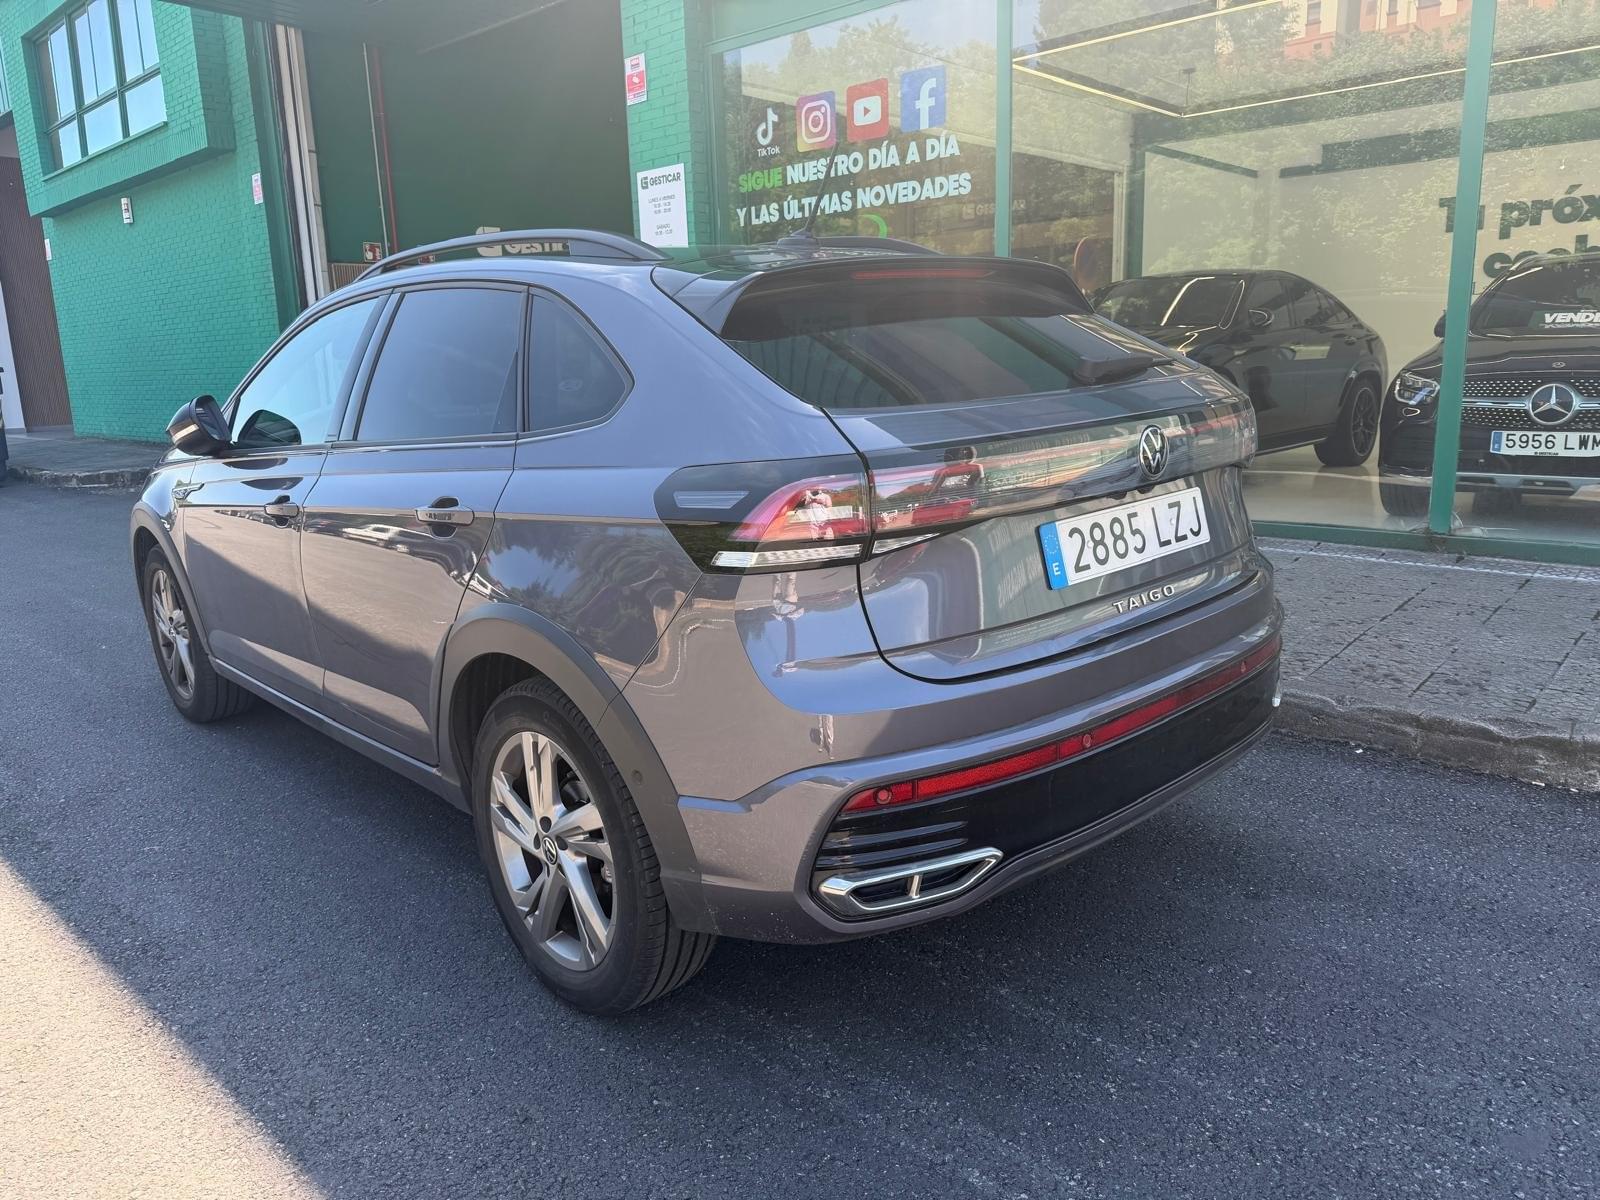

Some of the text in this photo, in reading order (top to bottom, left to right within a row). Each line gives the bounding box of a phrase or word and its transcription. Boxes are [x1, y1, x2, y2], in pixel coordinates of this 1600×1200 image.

[738, 129, 961, 193] SIGUE NUESTRO DÍA A DÍA
[757, 146, 781, 158] TikTok
[649, 172, 682, 186] GESTICAR
[736, 207, 748, 227] Y
[751, 203, 780, 226] LAS
[856, 172, 972, 209] NOVEDADES
[1505, 433, 1557, 450] 5956
[1052, 563, 1061, 576] E
[1067, 512, 1147, 574] 2885
[1151, 496, 1202, 548] LZJ
[1112, 585, 1176, 614] TAIGO
